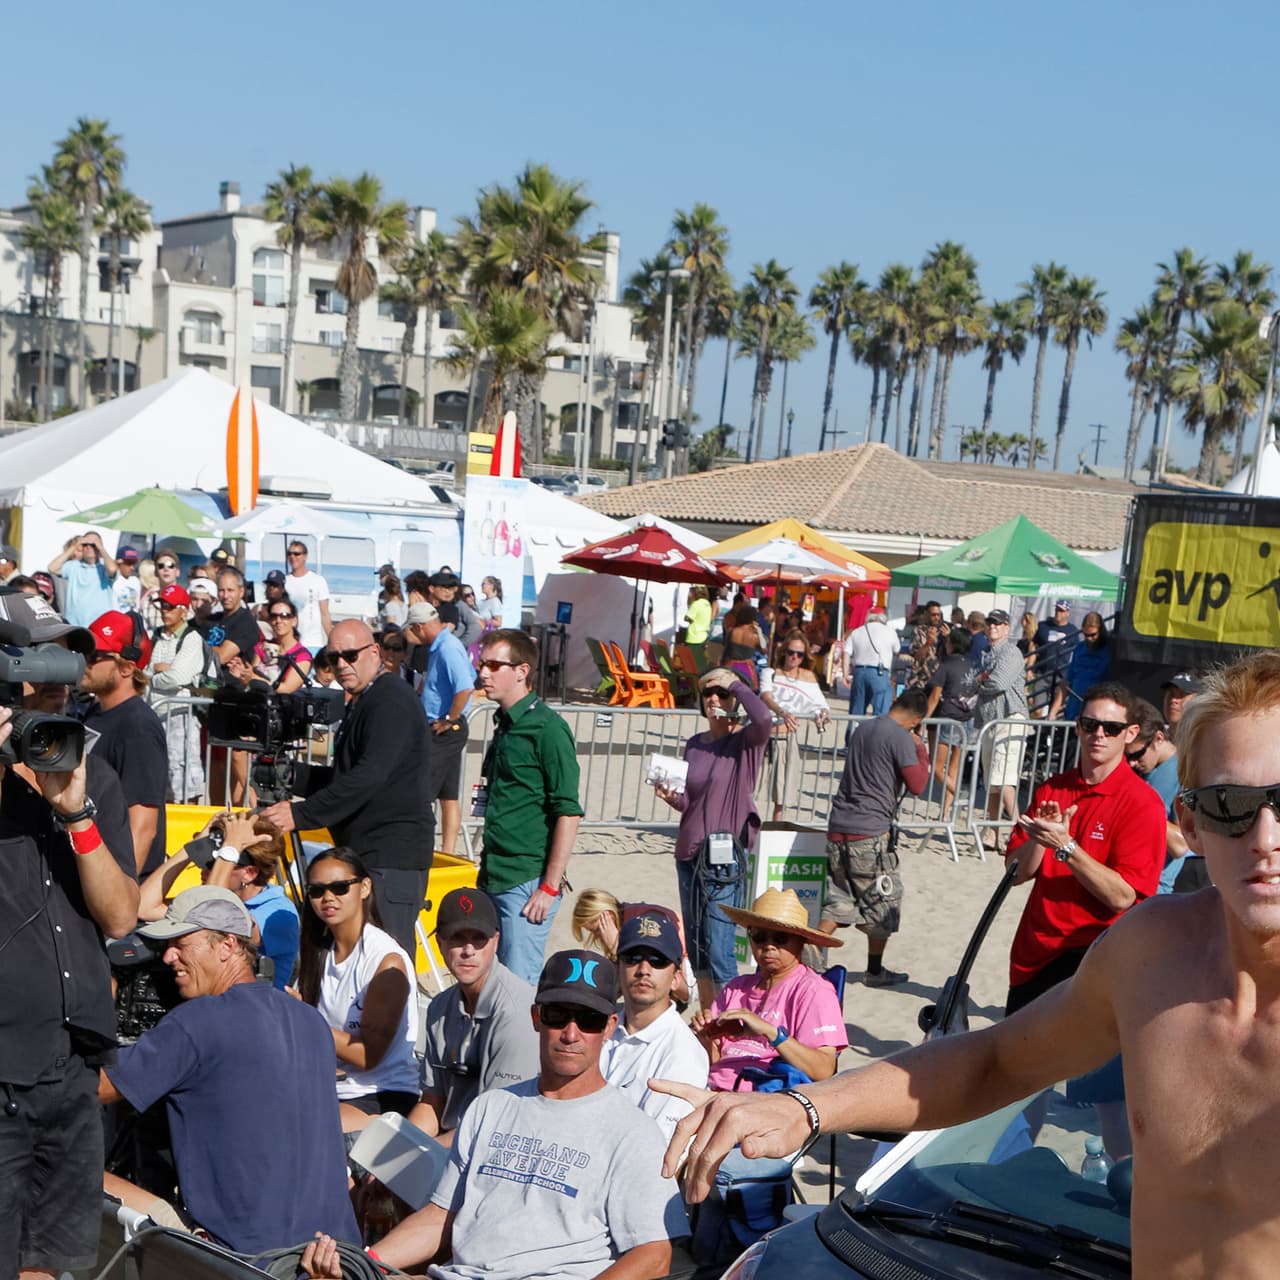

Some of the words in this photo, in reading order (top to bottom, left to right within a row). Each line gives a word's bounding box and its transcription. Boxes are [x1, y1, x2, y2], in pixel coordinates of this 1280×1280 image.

[1148, 564, 1231, 622] avp
[770, 862, 824, 876] TRASH
[494, 1071, 523, 1082] NAUTICA
[488, 1131, 591, 1169] RICHLAND
[482, 1166, 532, 1184] ELEMENTAR
[533, 1177, 567, 1193] SCHOOL
[489, 1149, 571, 1182] AVENUE
